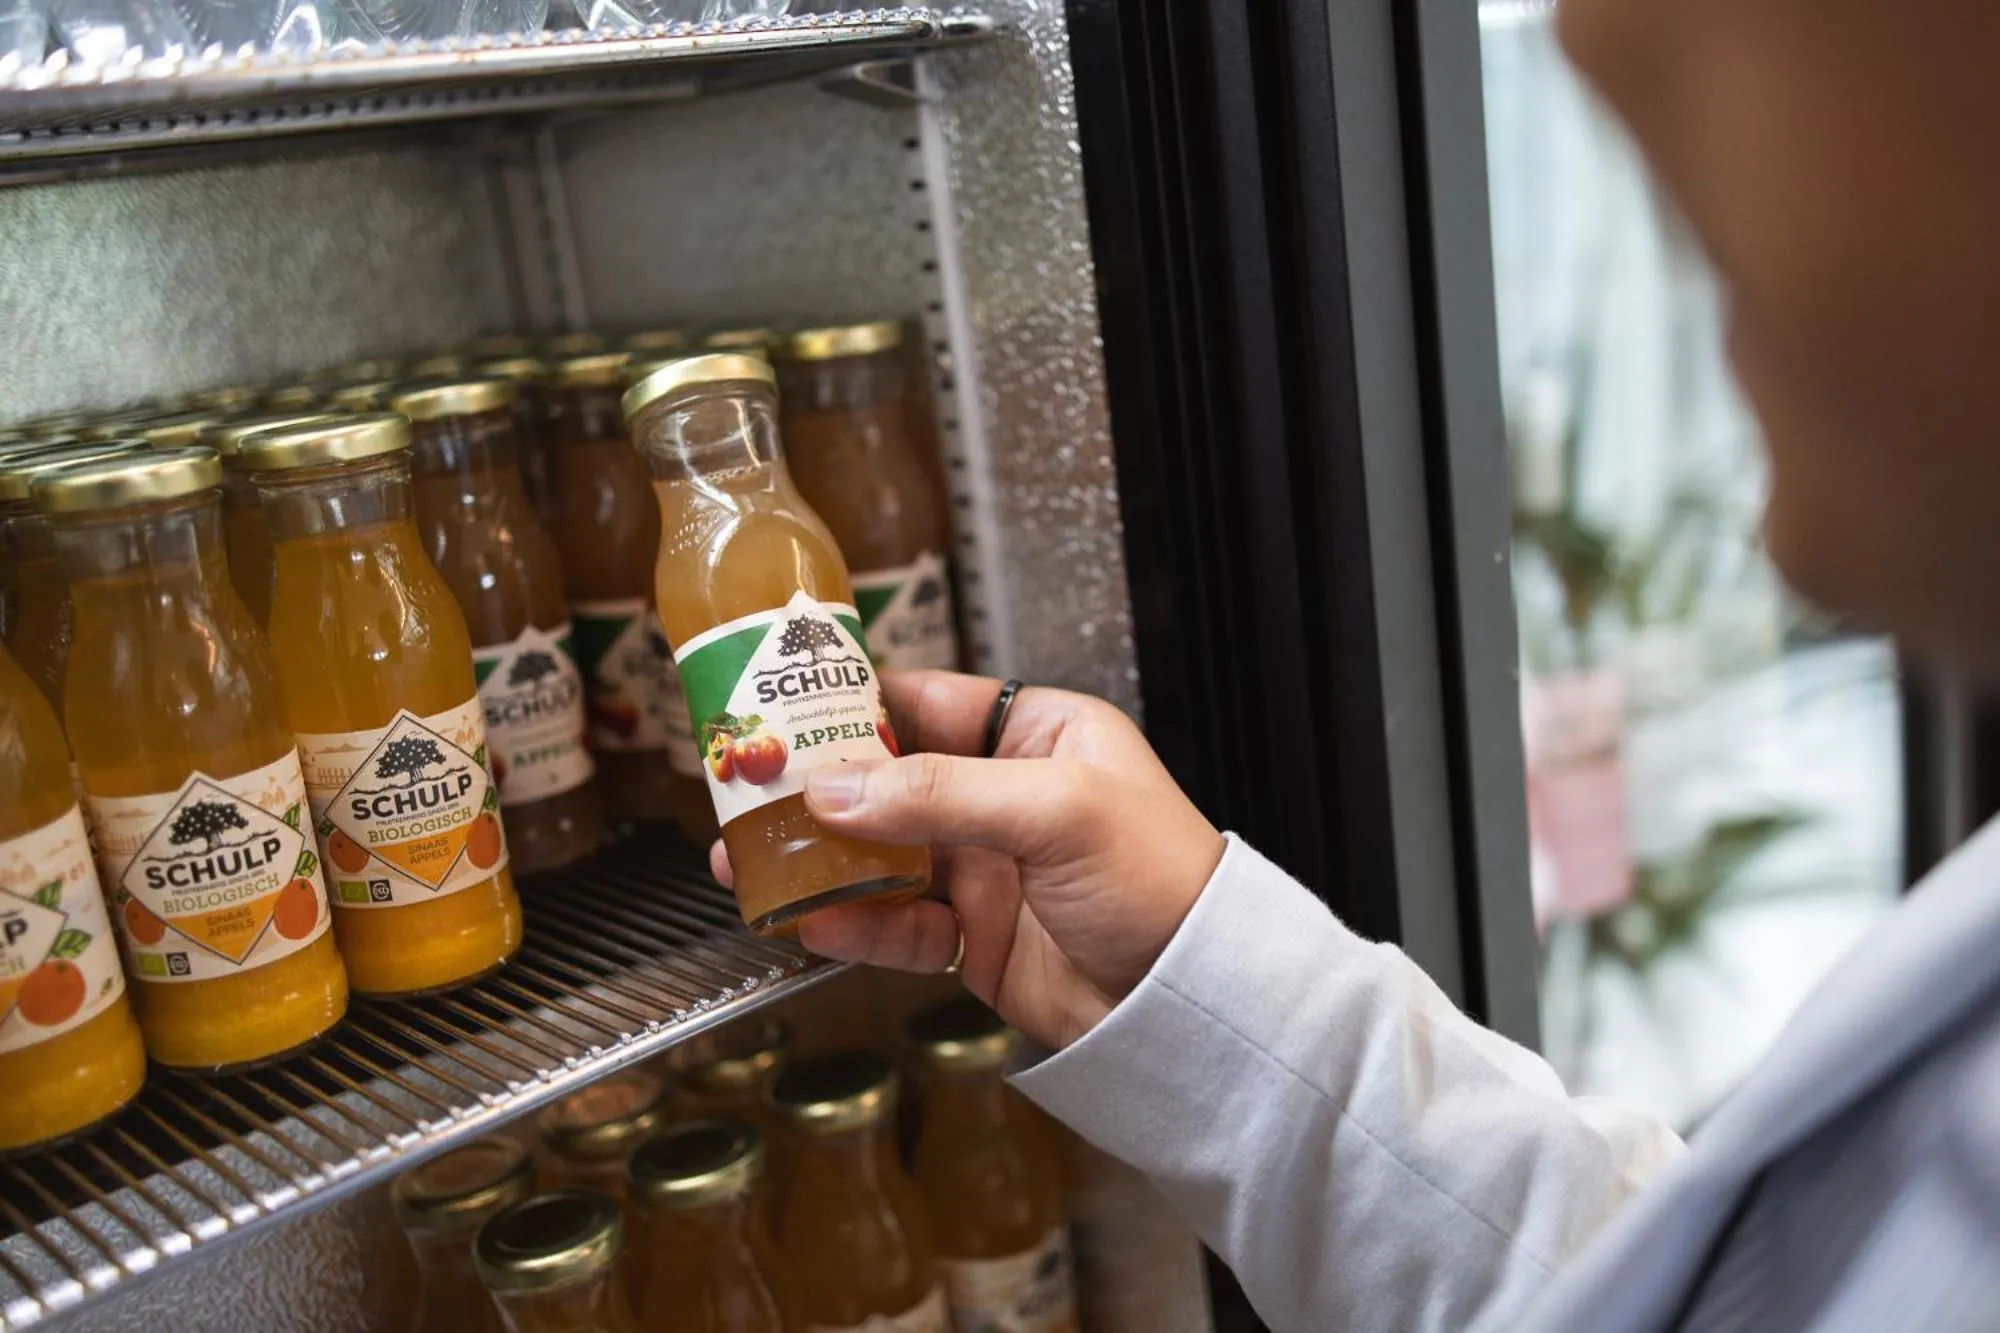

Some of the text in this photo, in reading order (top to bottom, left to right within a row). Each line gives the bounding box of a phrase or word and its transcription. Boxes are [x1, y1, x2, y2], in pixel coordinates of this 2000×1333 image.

[756, 666, 870, 705] SCHULP
[794, 721, 876, 751] APPELS
[351, 773, 473, 821] SCHULP
[368, 805, 473, 843] BIOLOGISCH
[146, 837, 282, 891] SCHULP
[162, 872, 280, 914] BIOLOGISCH
[0, 918, 28, 946] P
